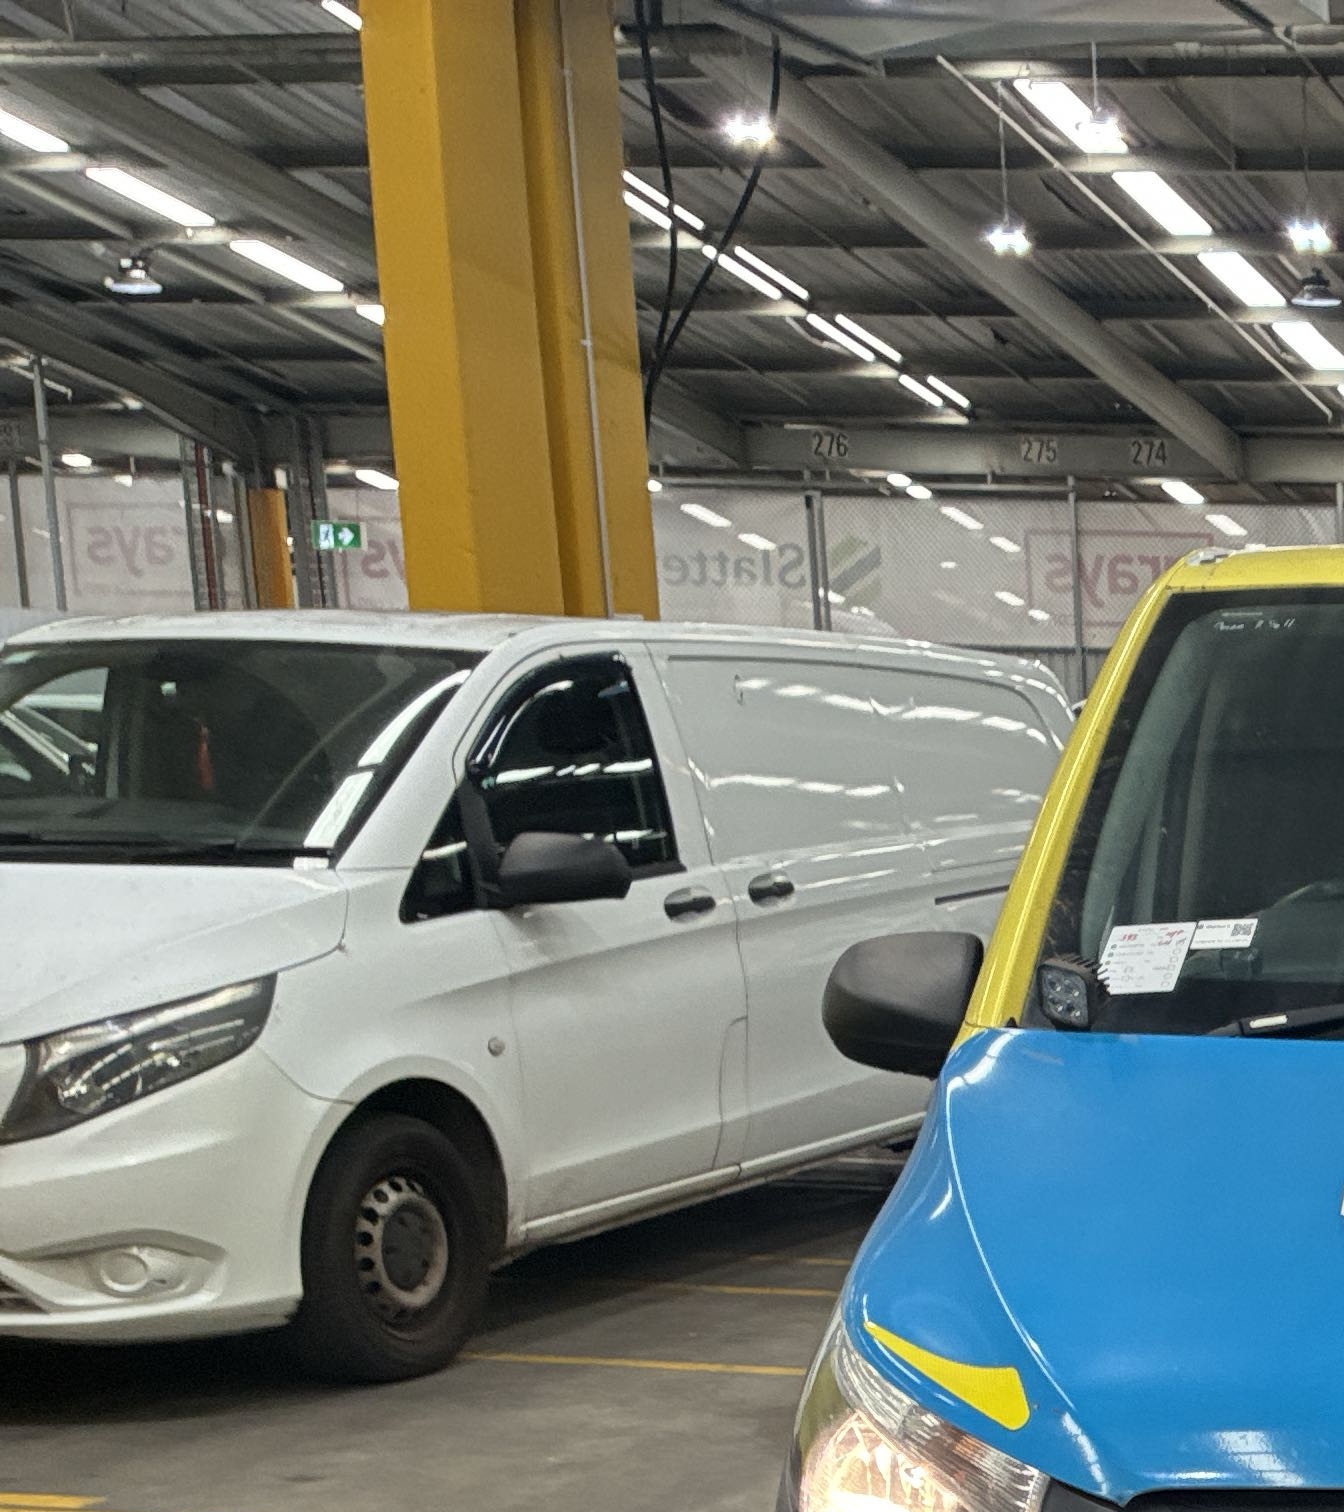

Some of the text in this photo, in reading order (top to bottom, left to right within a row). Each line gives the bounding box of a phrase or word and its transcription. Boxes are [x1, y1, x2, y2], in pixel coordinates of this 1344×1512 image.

[812, 431, 849, 457] 276
[1023, 438, 1057, 463] 275
[1131, 440, 1168, 465] 274
